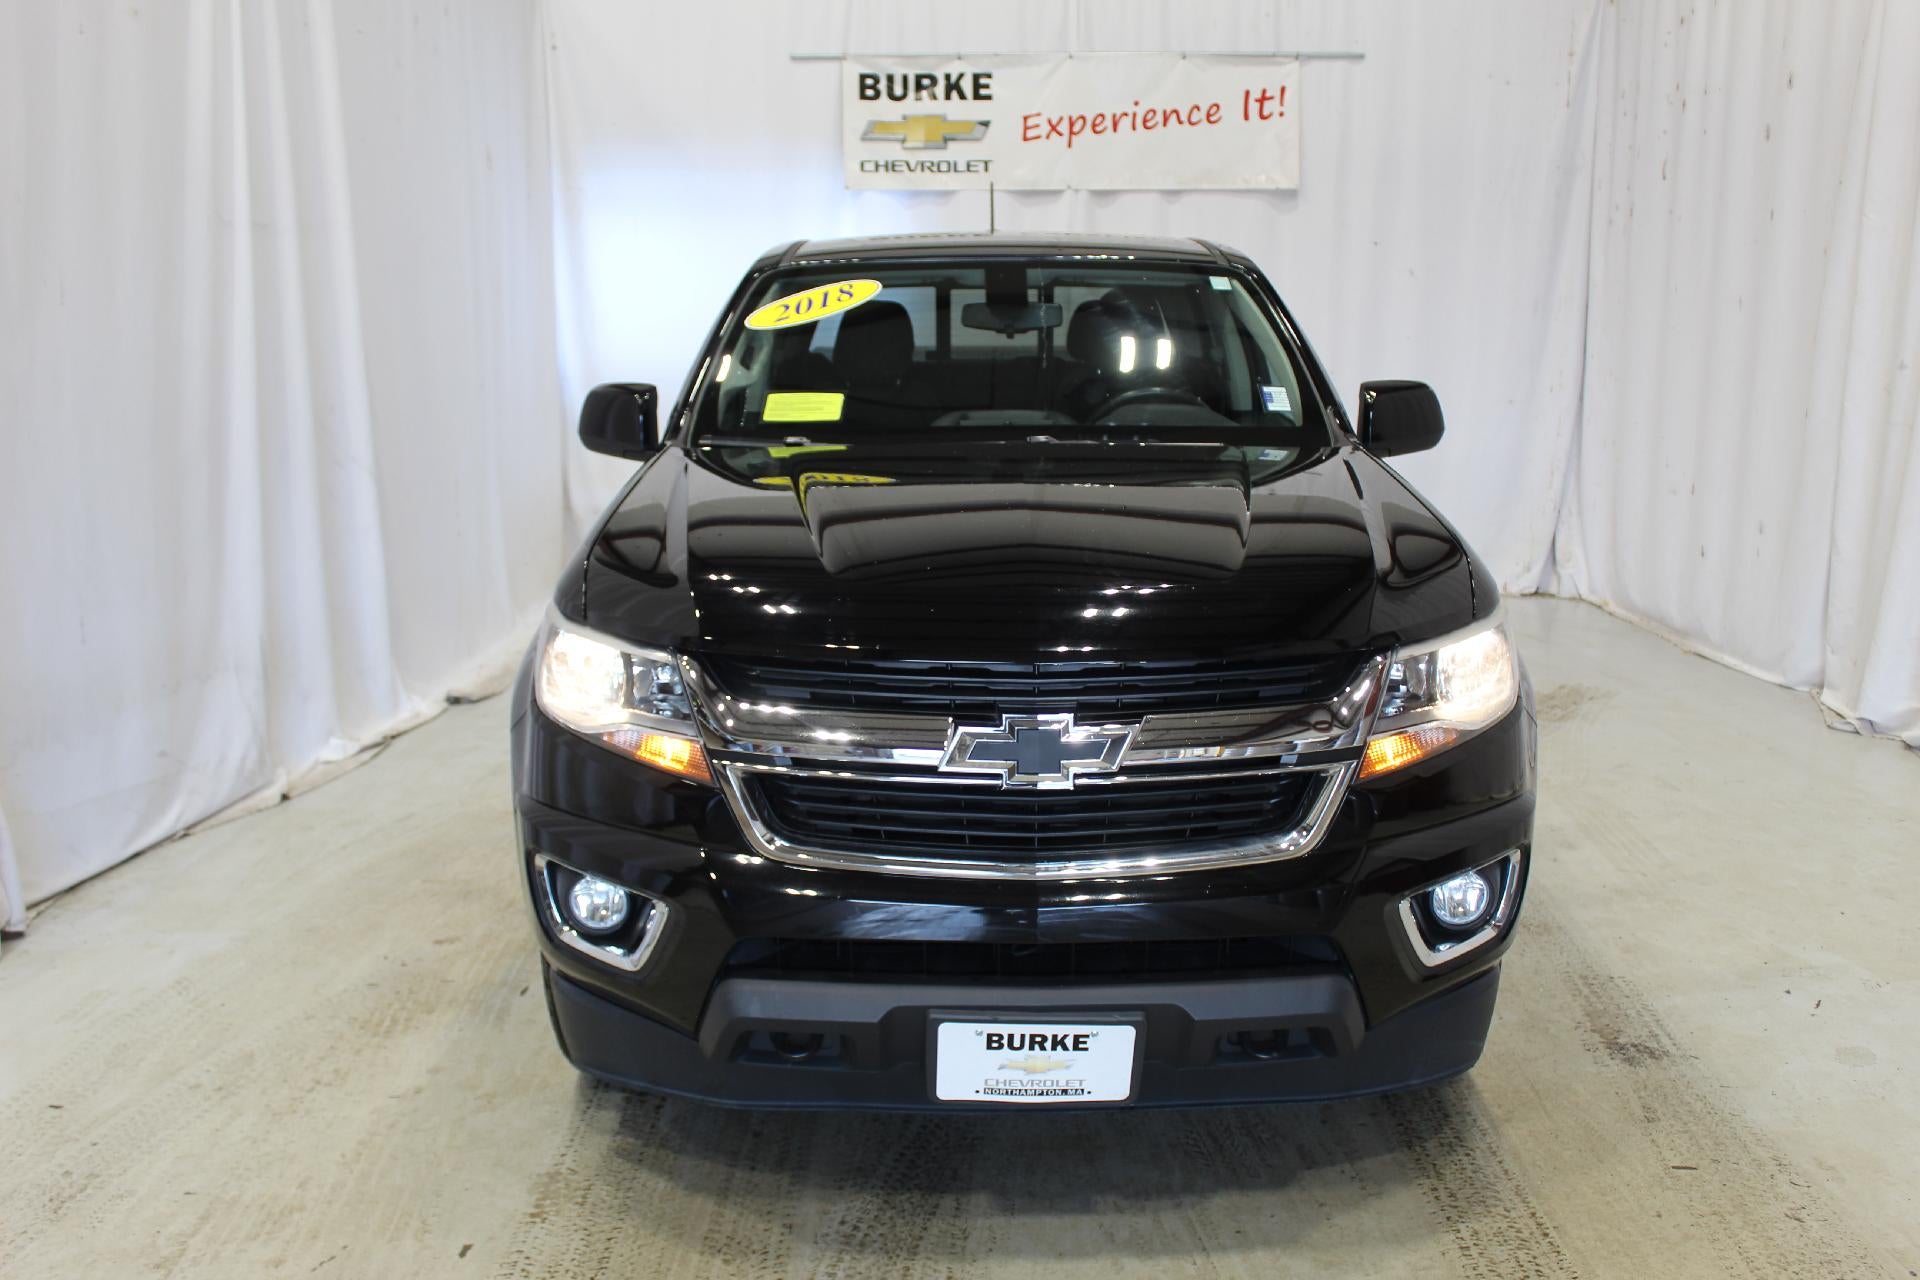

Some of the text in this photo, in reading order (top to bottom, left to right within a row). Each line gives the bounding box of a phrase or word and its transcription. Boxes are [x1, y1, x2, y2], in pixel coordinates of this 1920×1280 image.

[859, 72, 993, 101] BURKE
[1021, 86, 1287, 148] Experience It!
[860, 159, 994, 173] CHEVROLET
[774, 283, 854, 322] 2018
[986, 1033, 1090, 1051] BURKE
[984, 1078, 1086, 1088] CHEVROLET
[1066, 1088, 1084, 1096] MA
